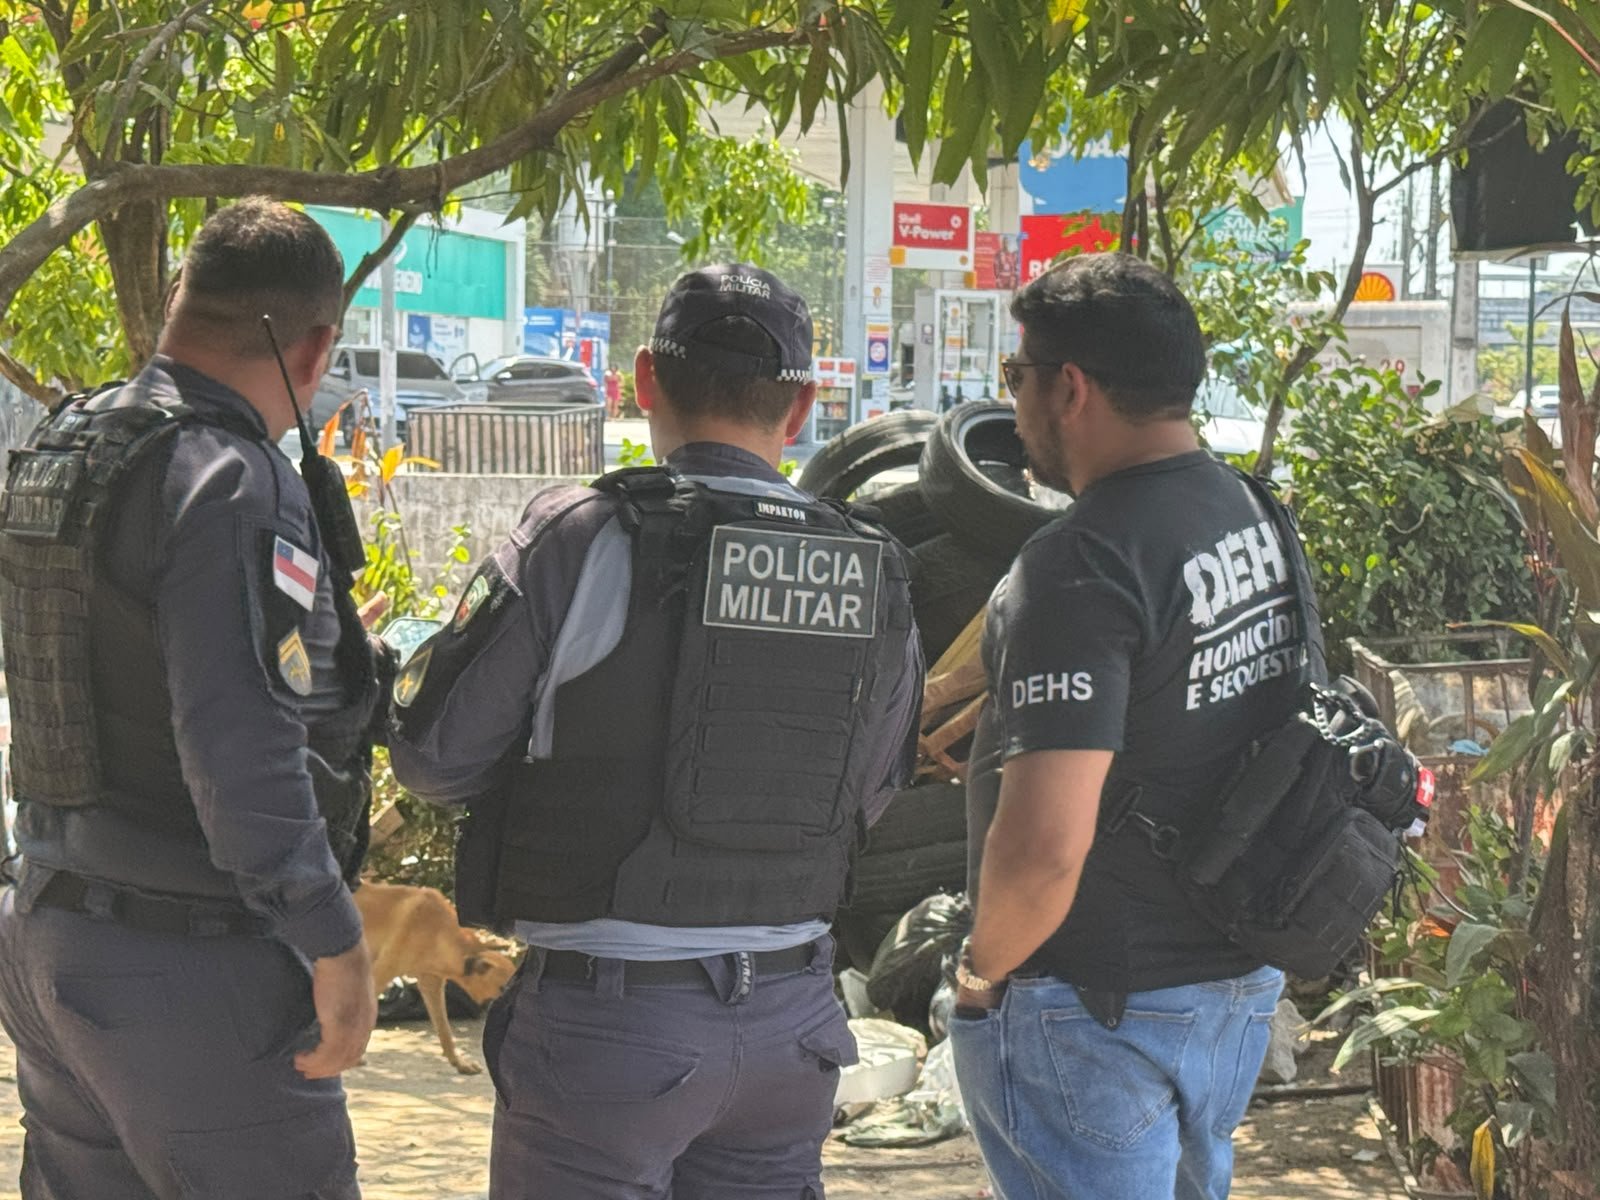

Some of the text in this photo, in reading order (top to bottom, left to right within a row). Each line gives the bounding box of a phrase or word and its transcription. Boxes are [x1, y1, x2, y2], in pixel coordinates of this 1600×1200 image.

[898, 225, 955, 240] V-Power
[719, 282, 771, 299] MILITAR
[720, 274, 771, 291] POLÍCIA
[723, 540, 865, 588] POLÍCIA
[1183, 520, 1289, 630] DEH
[719, 583, 862, 629] MILITAR
[1189, 608, 1299, 680] HOMICÍDI
[1012, 671, 1093, 709] DEHS
[1186, 645, 1307, 711] E SEQUEST
